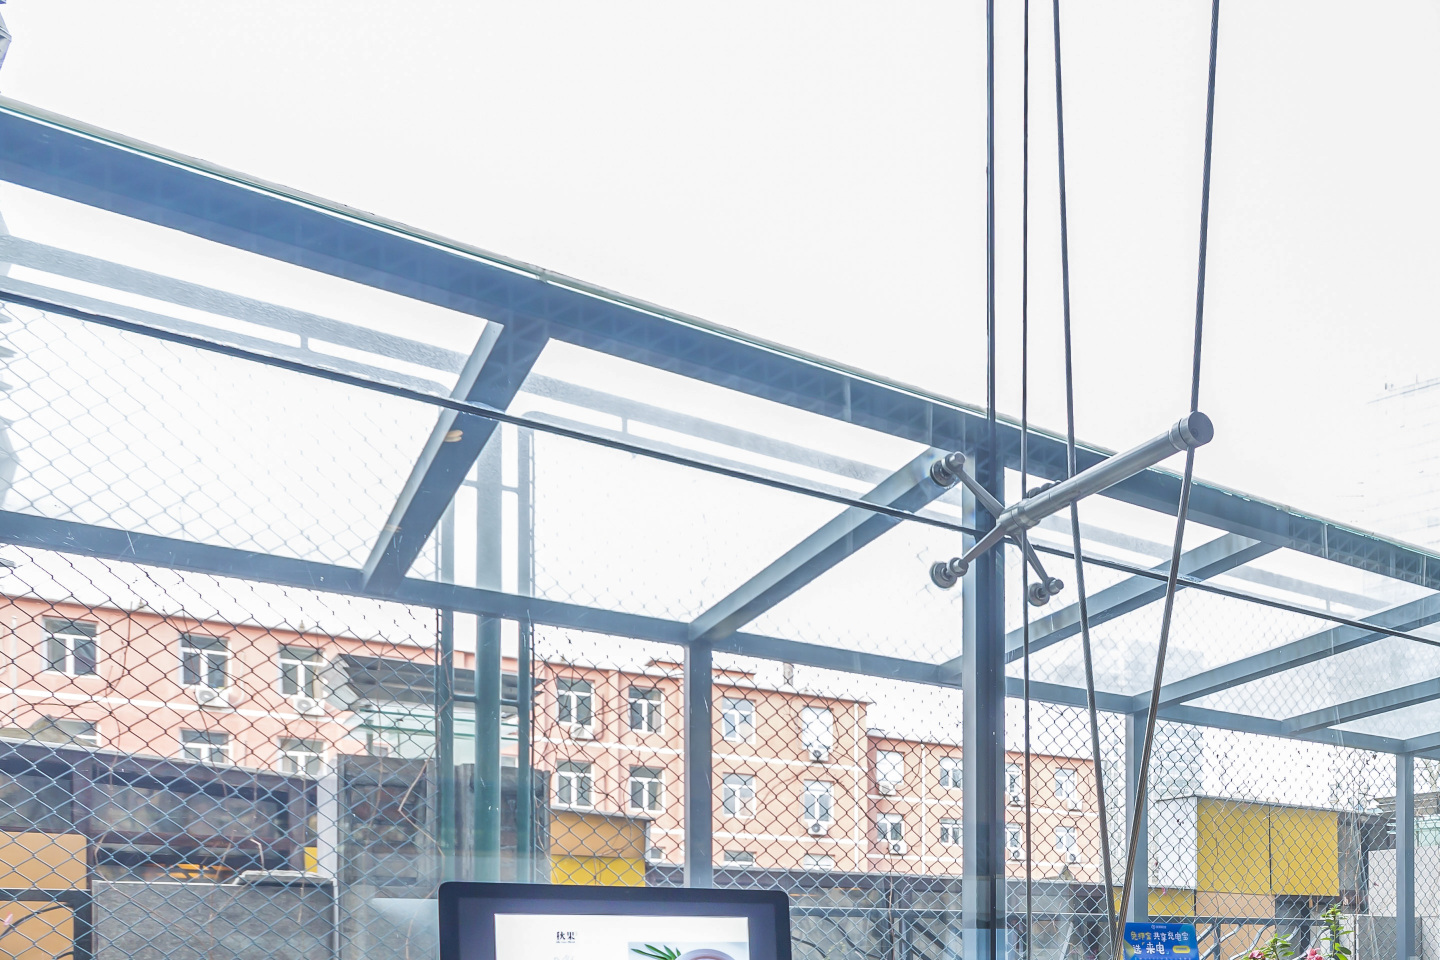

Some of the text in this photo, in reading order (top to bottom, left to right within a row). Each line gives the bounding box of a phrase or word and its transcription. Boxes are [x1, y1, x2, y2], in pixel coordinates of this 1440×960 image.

[1153, 931, 1189, 943] 共享充电宝
